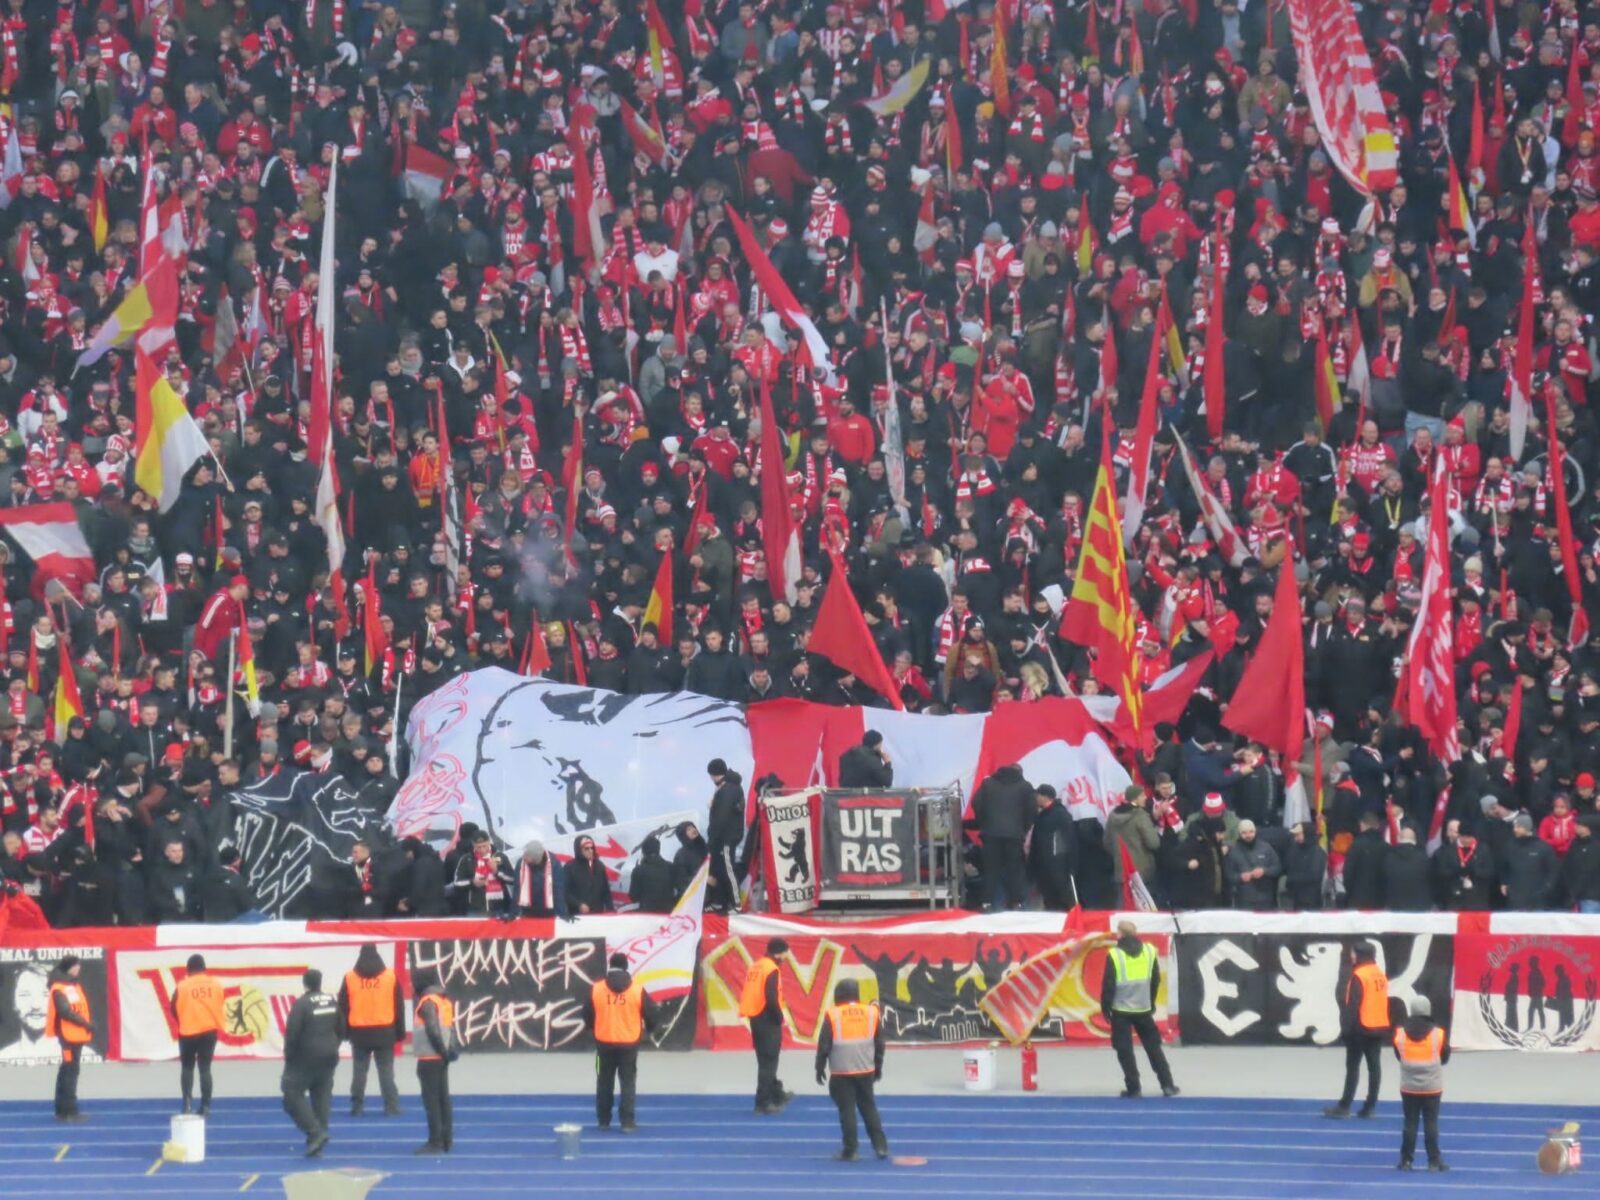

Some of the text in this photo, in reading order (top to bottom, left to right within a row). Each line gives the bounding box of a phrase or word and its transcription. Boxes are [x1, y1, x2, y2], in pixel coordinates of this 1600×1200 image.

[767, 804, 811, 823] UNION
[839, 808, 902, 838] ULT
[840, 842, 902, 873] RAS
[0, 947, 104, 961] MAL UNIONER
[413, 938, 598, 992] HAMMER
[191, 987, 213, 999] 051
[605, 994, 626, 1006] 175
[1199, 938, 1260, 1037] E
[452, 995, 586, 1051] HEARTS
